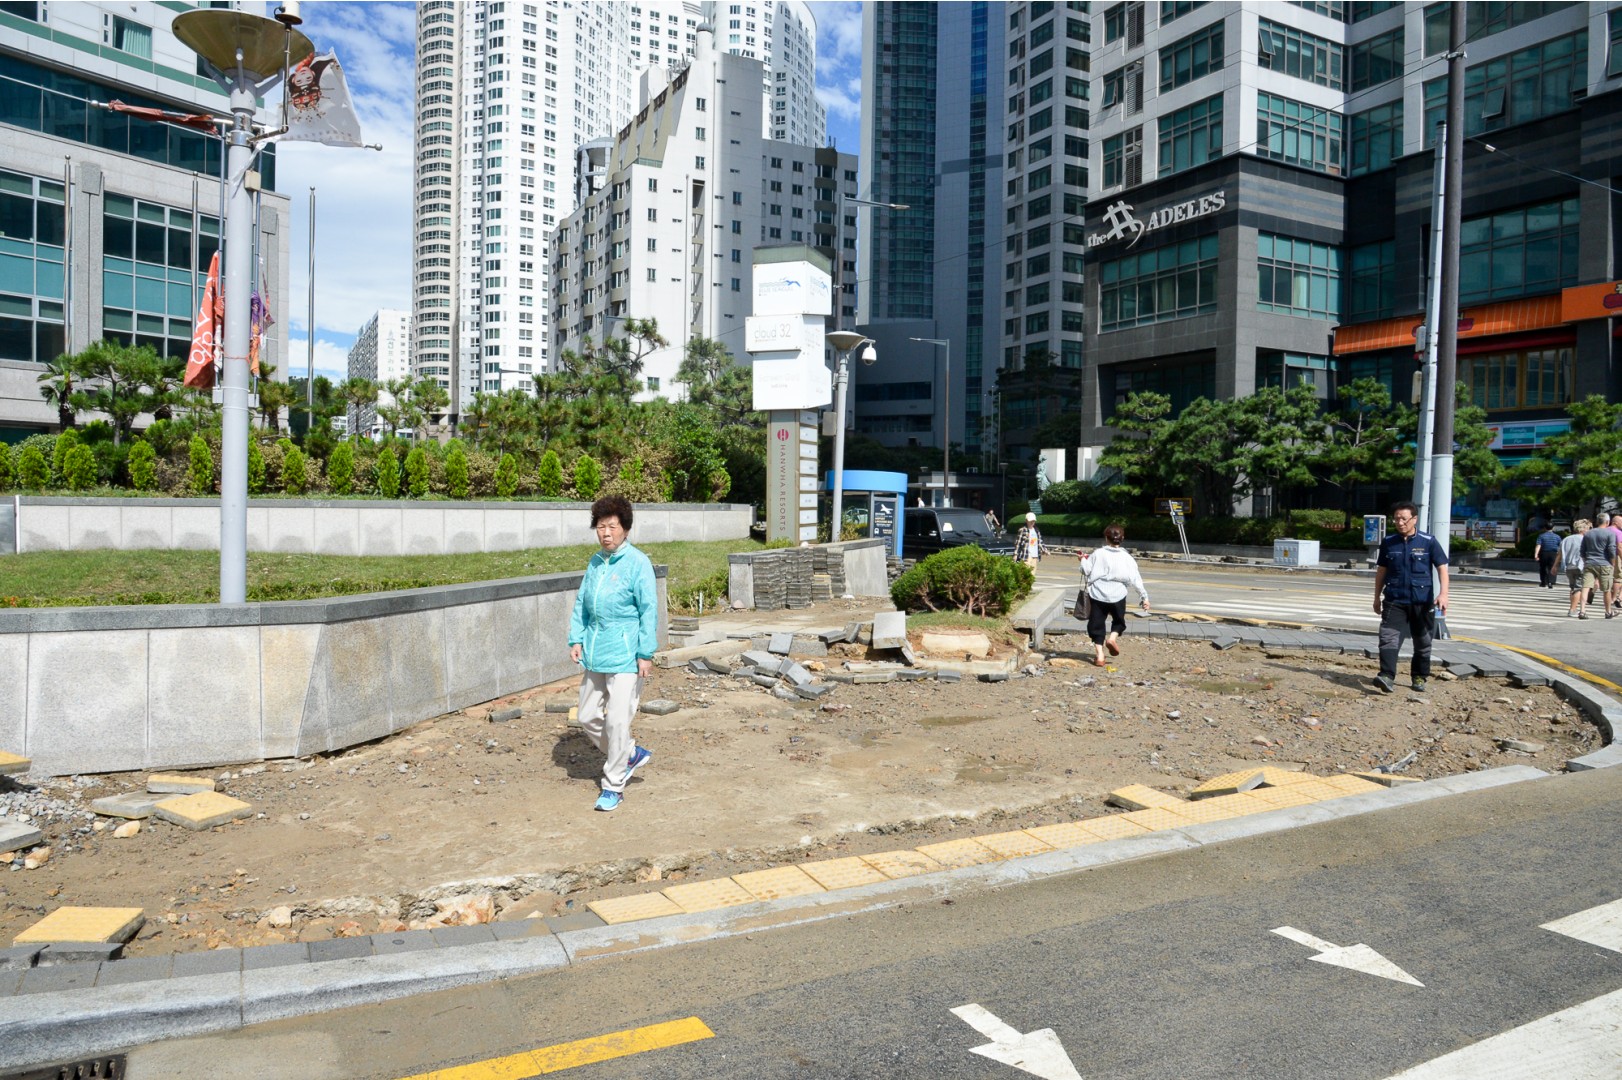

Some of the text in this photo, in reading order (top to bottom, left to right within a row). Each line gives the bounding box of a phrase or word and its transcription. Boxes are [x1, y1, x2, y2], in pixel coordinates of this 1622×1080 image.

[1087, 190, 1226, 248] the ADELES
[754, 323, 777, 339] cloud
[780, 323, 791, 338] 32
